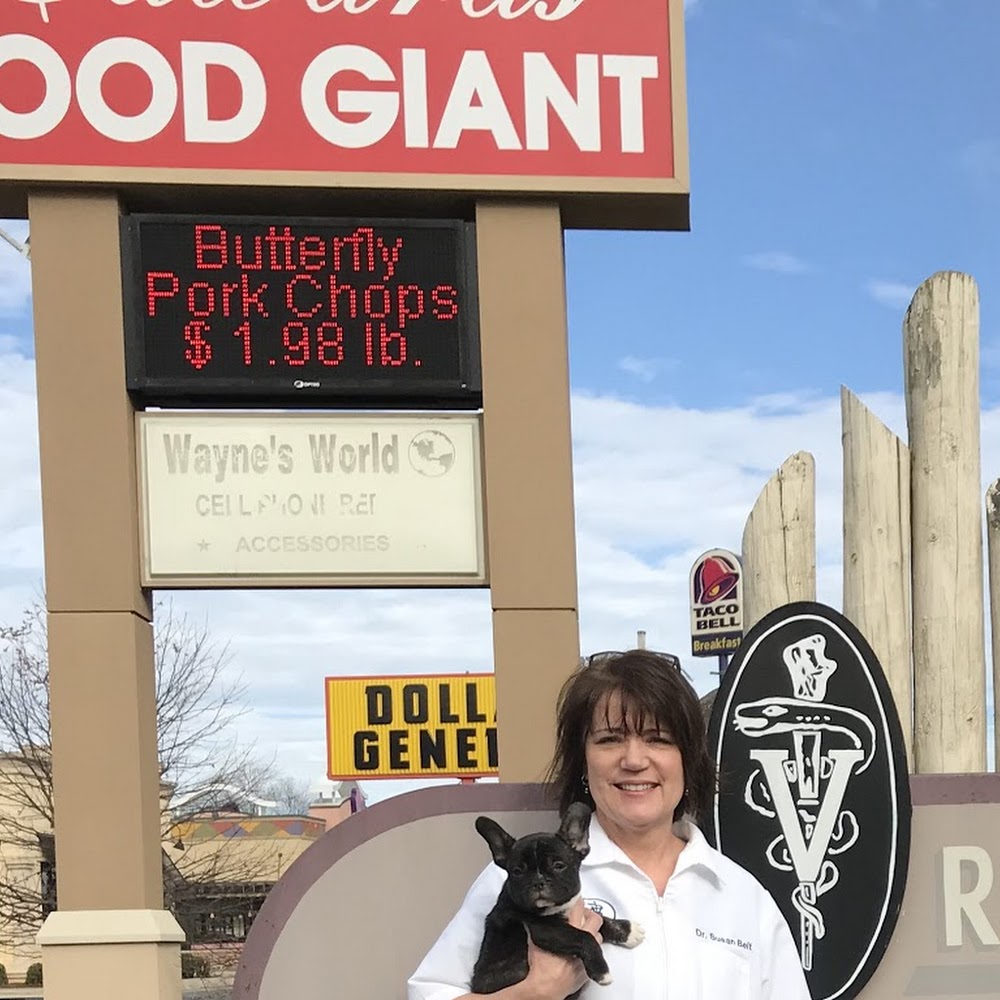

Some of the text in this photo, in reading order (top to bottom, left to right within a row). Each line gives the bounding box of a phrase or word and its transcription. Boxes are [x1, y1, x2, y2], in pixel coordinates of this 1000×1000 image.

[300, 44, 659, 153] GIANT
[195, 225, 403, 280] Butterfly
[147, 271, 458, 328] Pork Chops
[365, 323, 421, 366] lb.
[162, 431, 400, 484] Wayne's World
[235, 534, 390, 553] ACCESSORIES
[693, 603, 740, 618] TACO
[696, 616, 741, 631] BELL
[693, 637, 742, 652] Breakfast
[364, 683, 497, 726] DOLL
